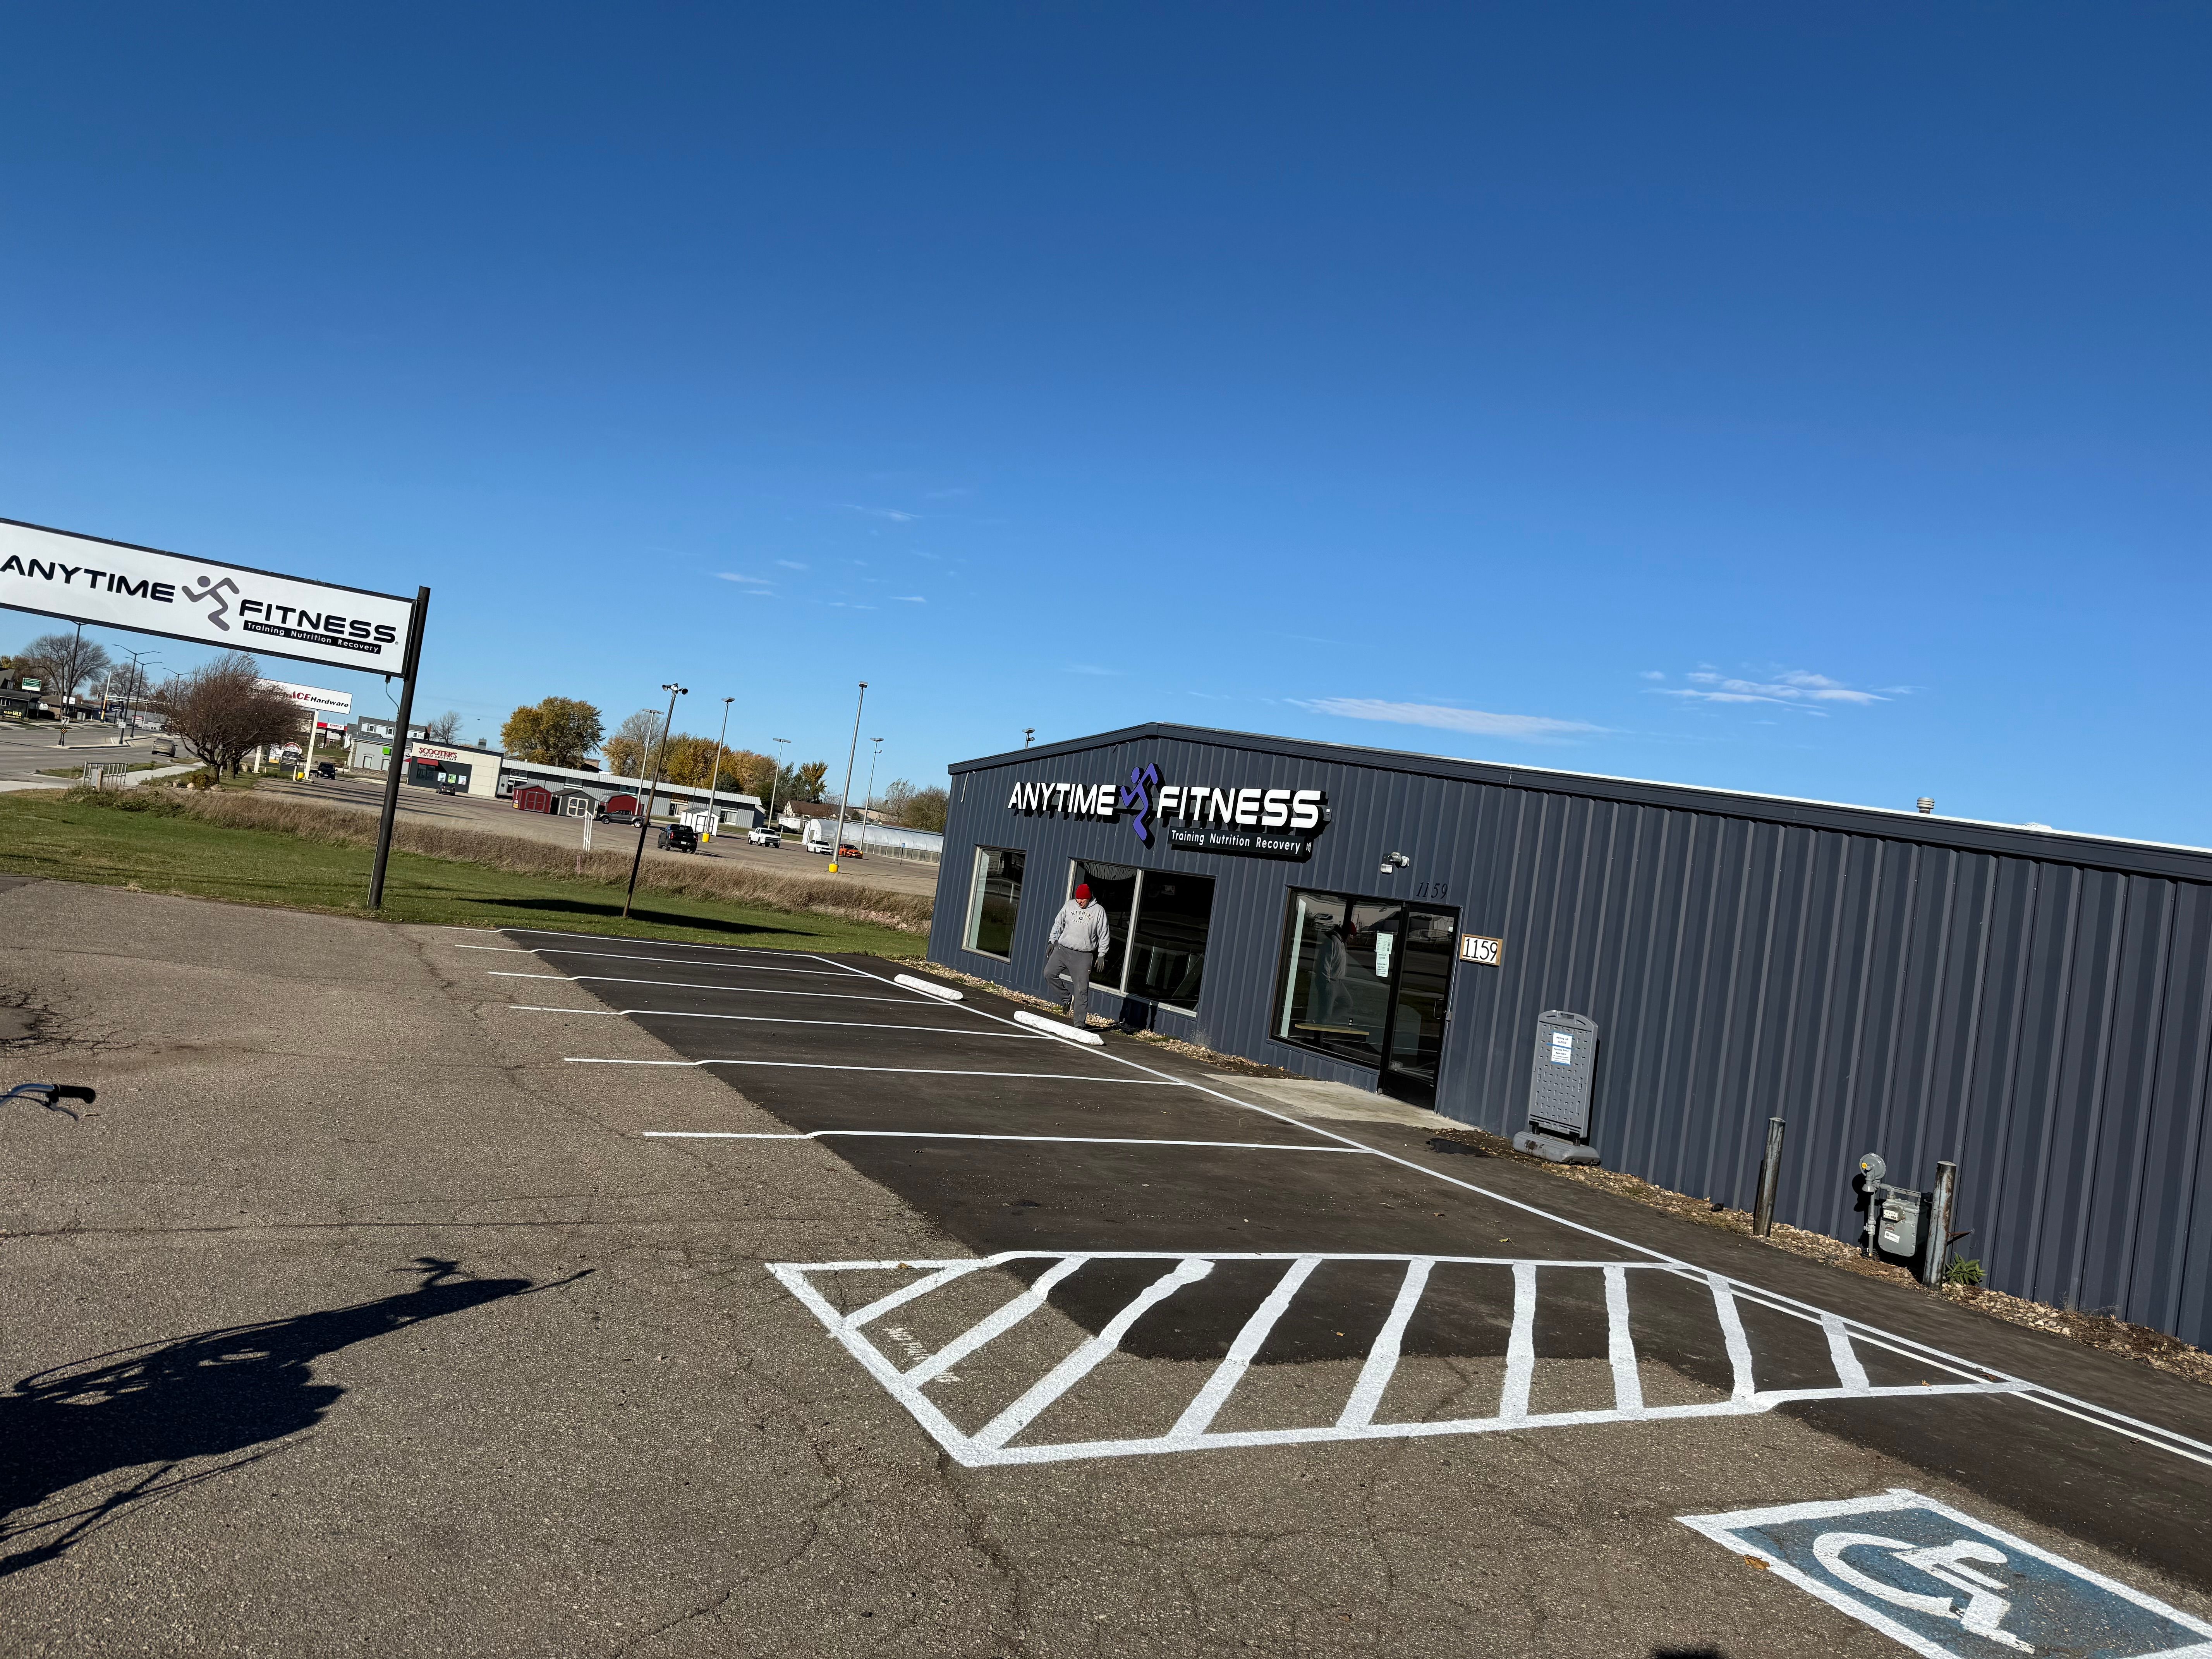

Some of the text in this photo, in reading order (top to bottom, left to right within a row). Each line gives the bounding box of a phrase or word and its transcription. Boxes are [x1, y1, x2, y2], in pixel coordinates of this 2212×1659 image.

[0, 555, 396, 643] ANYTIME FITNESS
[247, 622, 379, 653] Training Nutrition Recovery
[311, 696, 349, 708] Hardware
[1007, 781, 1321, 828] ANYTIME FITNESS
[1171, 830, 1204, 845] Training
[1210, 833, 1250, 847] Nutrition
[1256, 836, 1301, 854] Recovery
[1415, 881, 1448, 899] 1159
[1463, 938, 1498, 962] 1159
